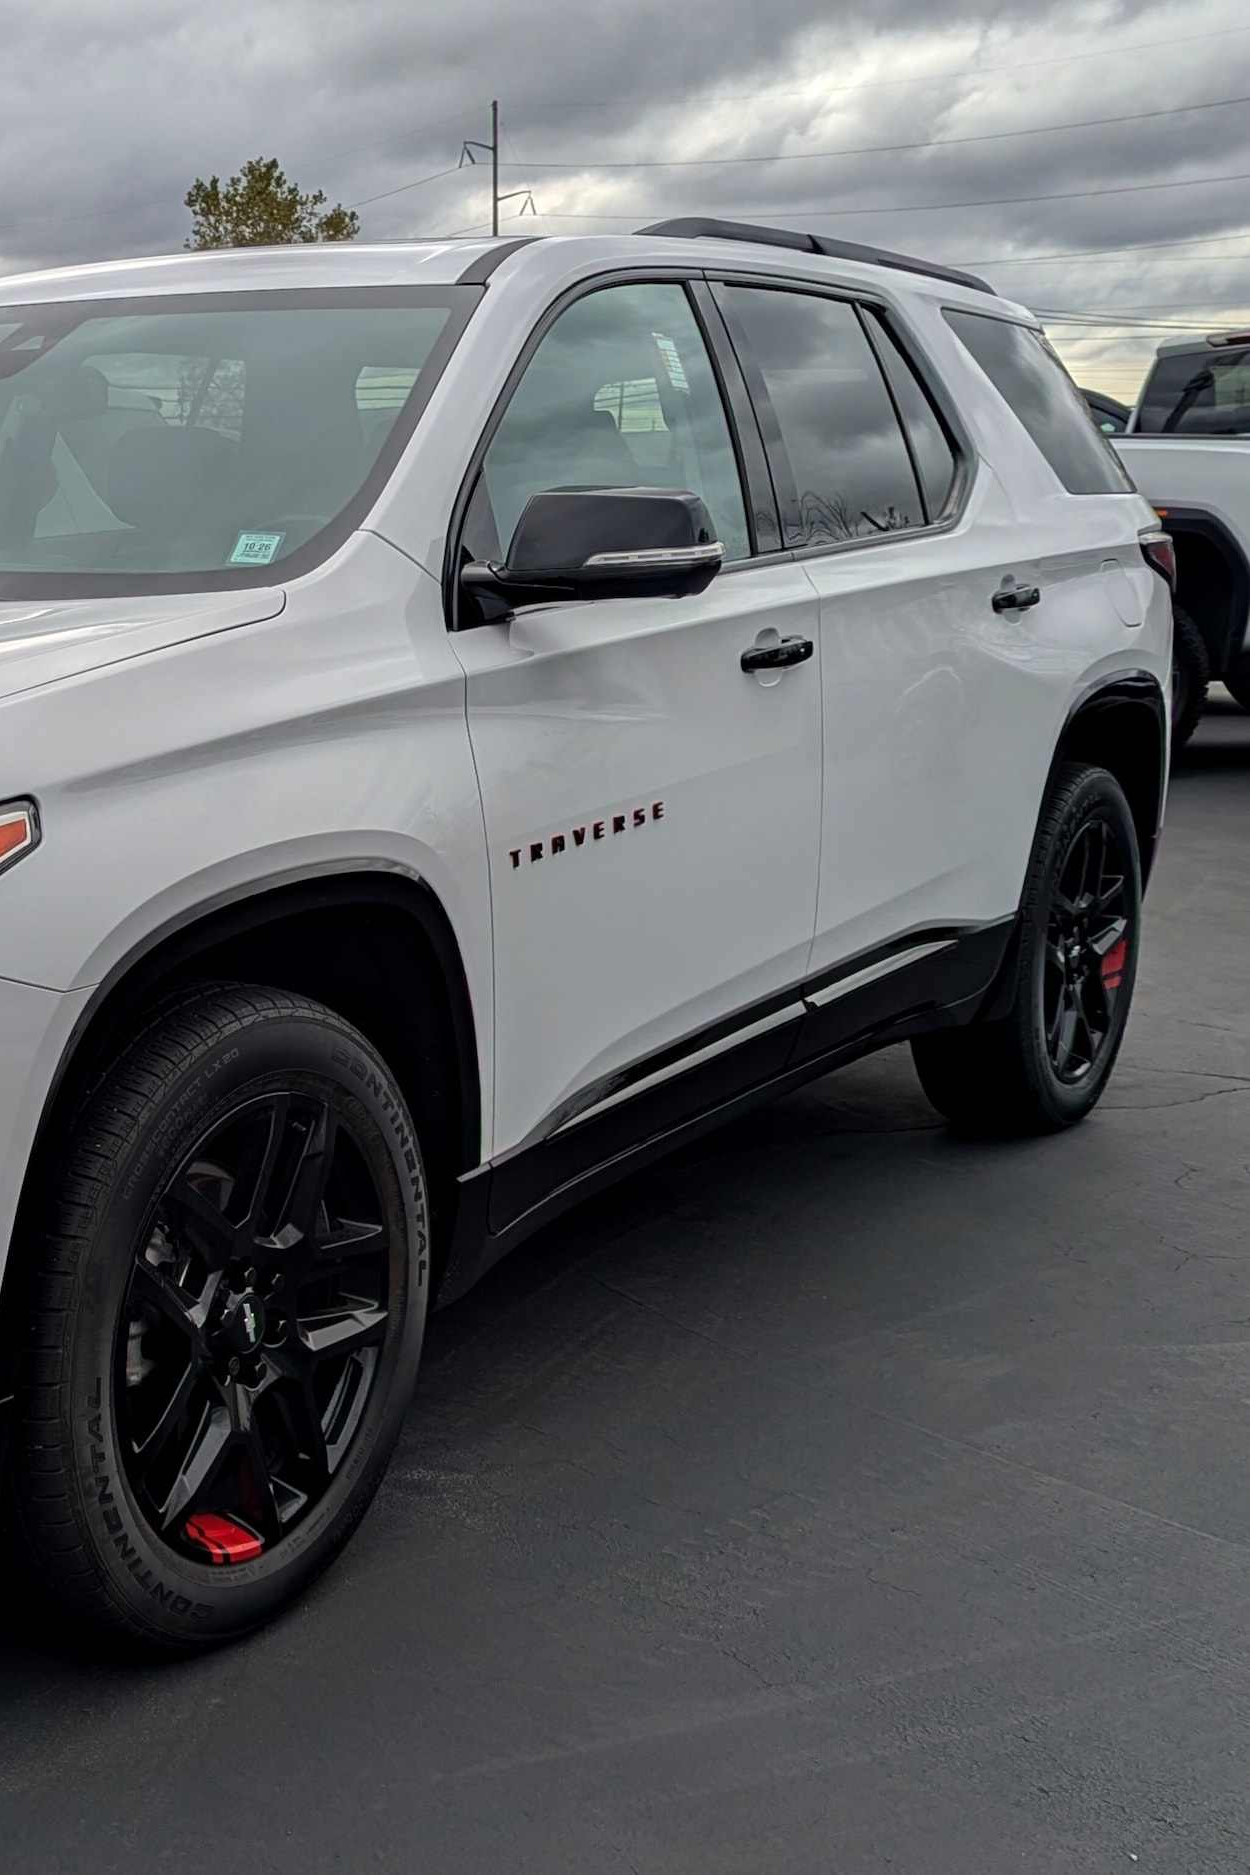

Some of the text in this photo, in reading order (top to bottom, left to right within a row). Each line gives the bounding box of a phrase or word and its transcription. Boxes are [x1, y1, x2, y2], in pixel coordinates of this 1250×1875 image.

[509, 801, 665, 869] TRAVERSE
[122, 1047, 240, 1201] CROSSCONTACT LX 20
[331, 1047, 428, 1287] CONTINENTAL
[87, 1376, 215, 1624] CONTINENTAL
